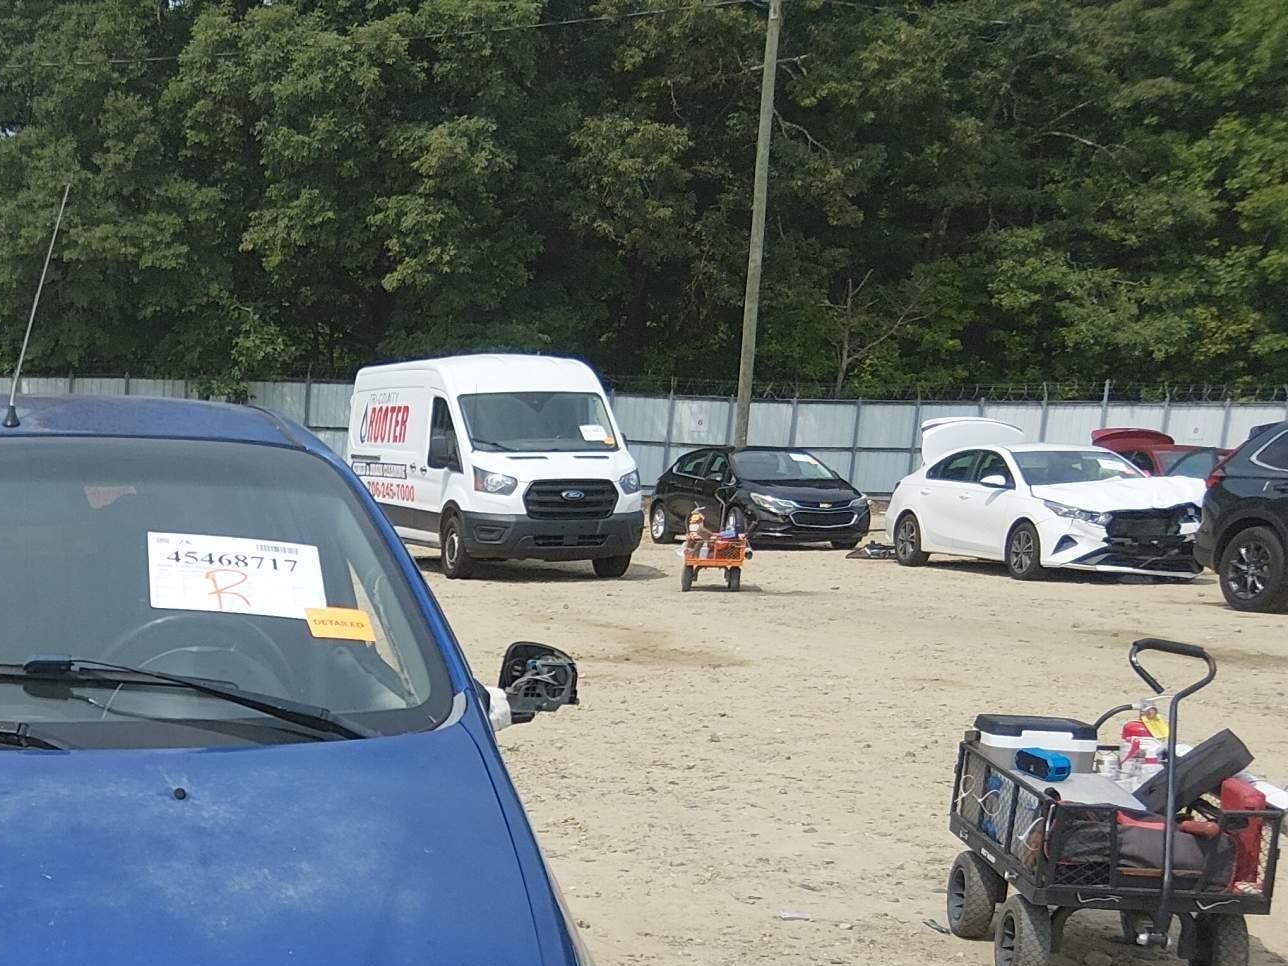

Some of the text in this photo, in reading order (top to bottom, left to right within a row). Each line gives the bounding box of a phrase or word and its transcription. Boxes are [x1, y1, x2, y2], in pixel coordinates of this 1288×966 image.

[367, 405, 410, 443] ROOTER
[167, 550, 298, 573] 45468717
[205, 569, 252, 610] R
